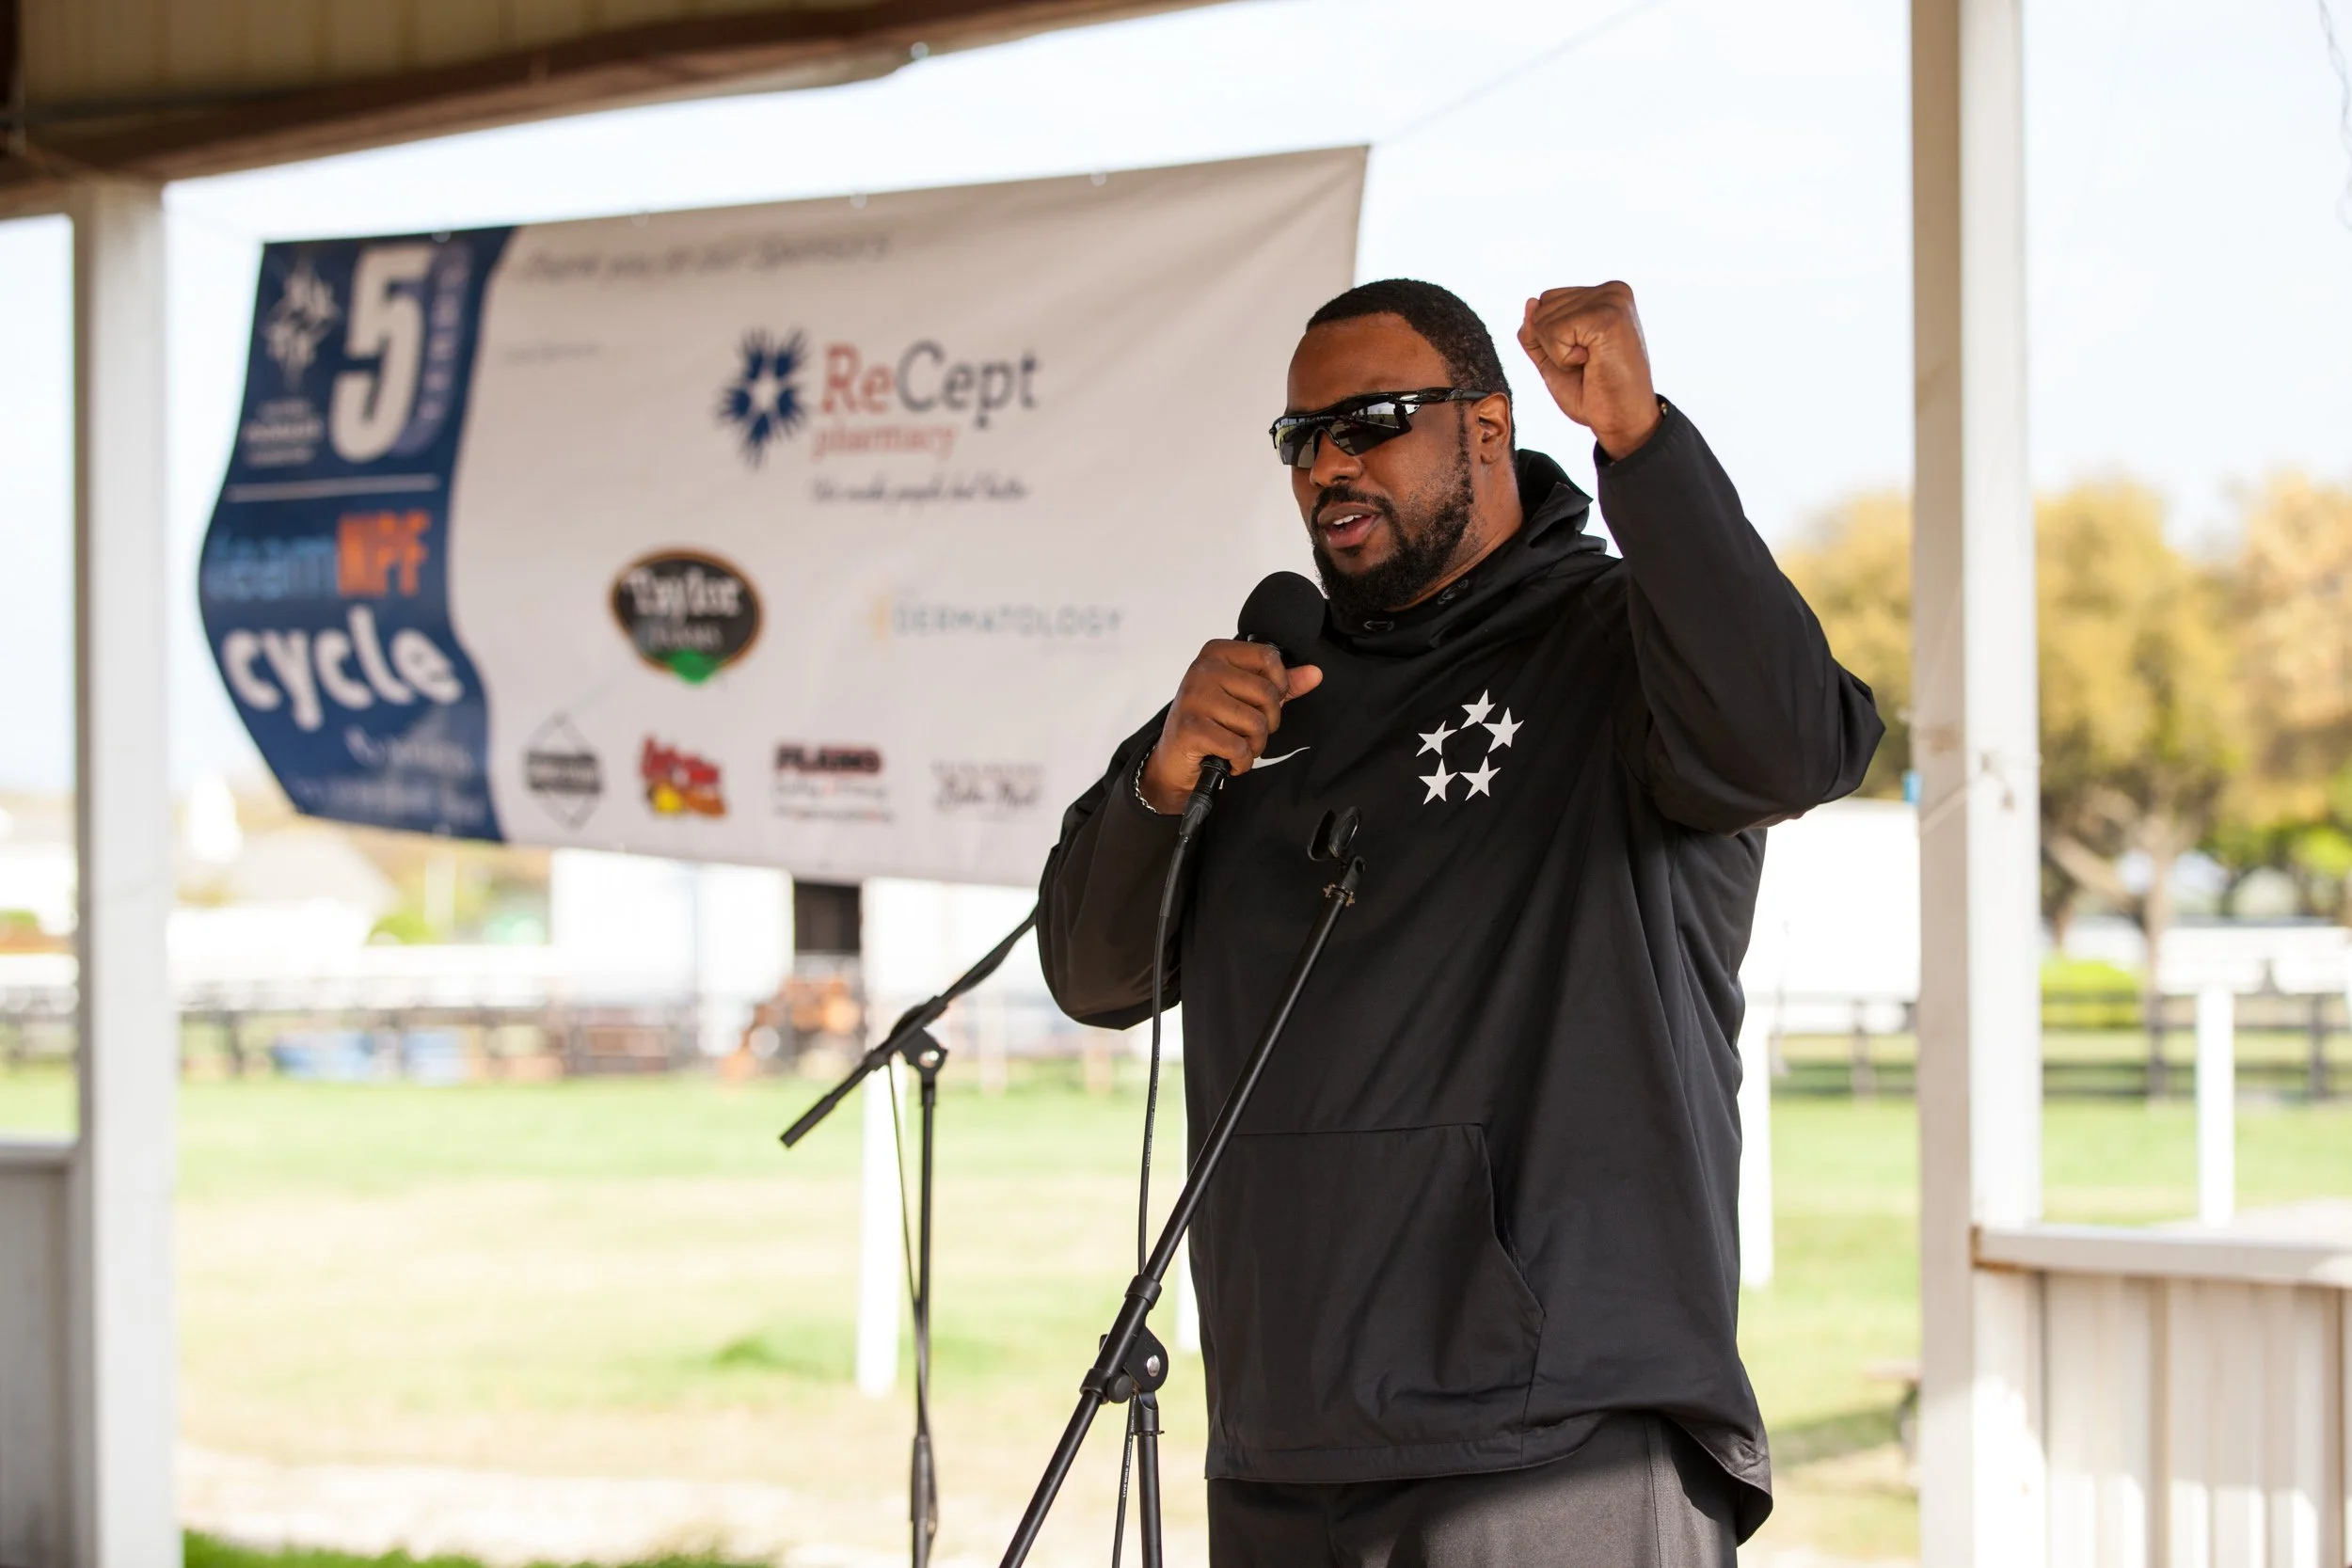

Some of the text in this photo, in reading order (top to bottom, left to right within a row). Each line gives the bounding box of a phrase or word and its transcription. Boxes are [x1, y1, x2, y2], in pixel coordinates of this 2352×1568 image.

[330, 245, 435, 463] 5
[820, 339, 1042, 429] ReCept
[811, 423, 957, 459] pharmacy
[892, 603, 1126, 639] DERMATOLOGY
[221, 605, 463, 731] cycle
